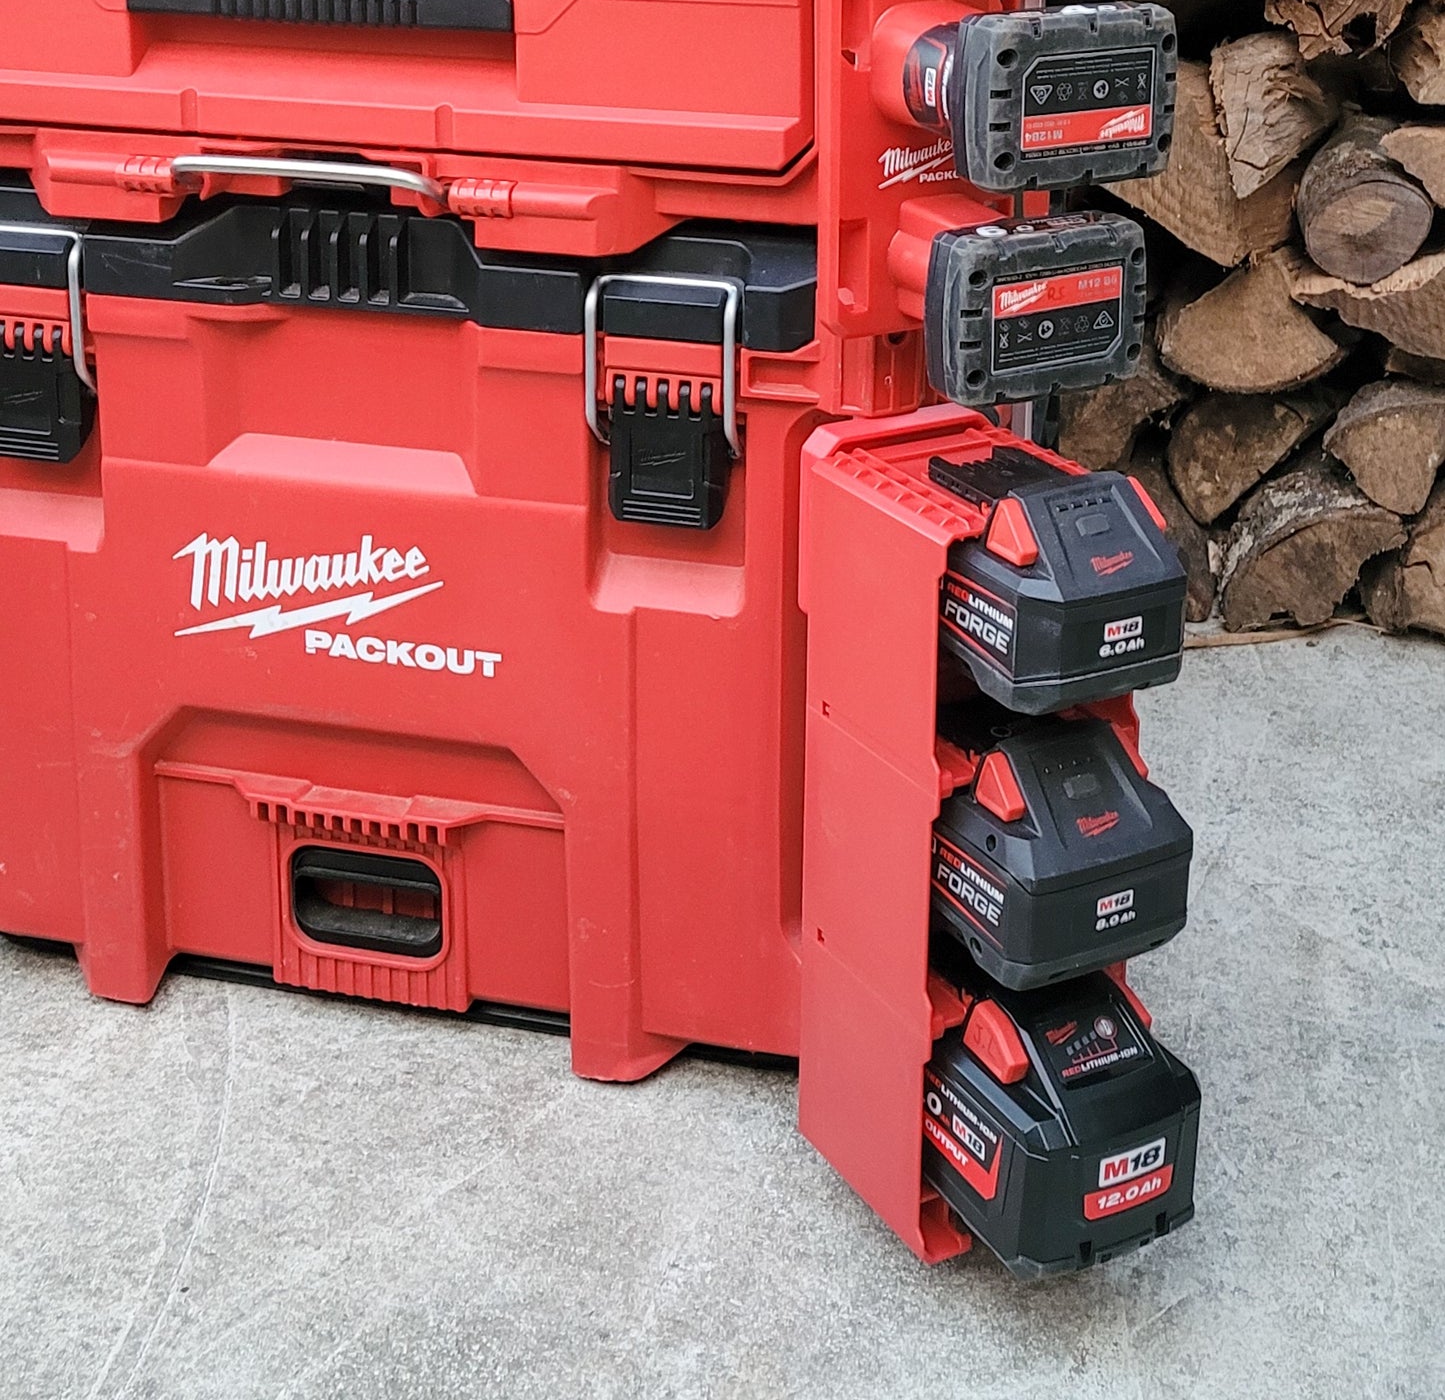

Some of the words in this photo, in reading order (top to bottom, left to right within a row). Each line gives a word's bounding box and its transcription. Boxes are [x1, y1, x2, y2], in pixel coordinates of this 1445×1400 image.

[878, 137, 953, 178] Milwauke
[919, 169, 960, 184] PACK
[172, 532, 430, 611] Milwaukee
[945, 599, 1010, 655] FORGE
[1106, 619, 1140, 639] M18
[304, 629, 502, 678] PACKOUT
[937, 863, 1002, 927] FORGE
[1099, 892, 1132, 914] M18
[925, 1119, 969, 1167] OUTPUT
[953, 1118, 984, 1157] M18
[1103, 1145, 1162, 1181] M18
[1098, 1177, 1162, 1210] 12.0Ah
